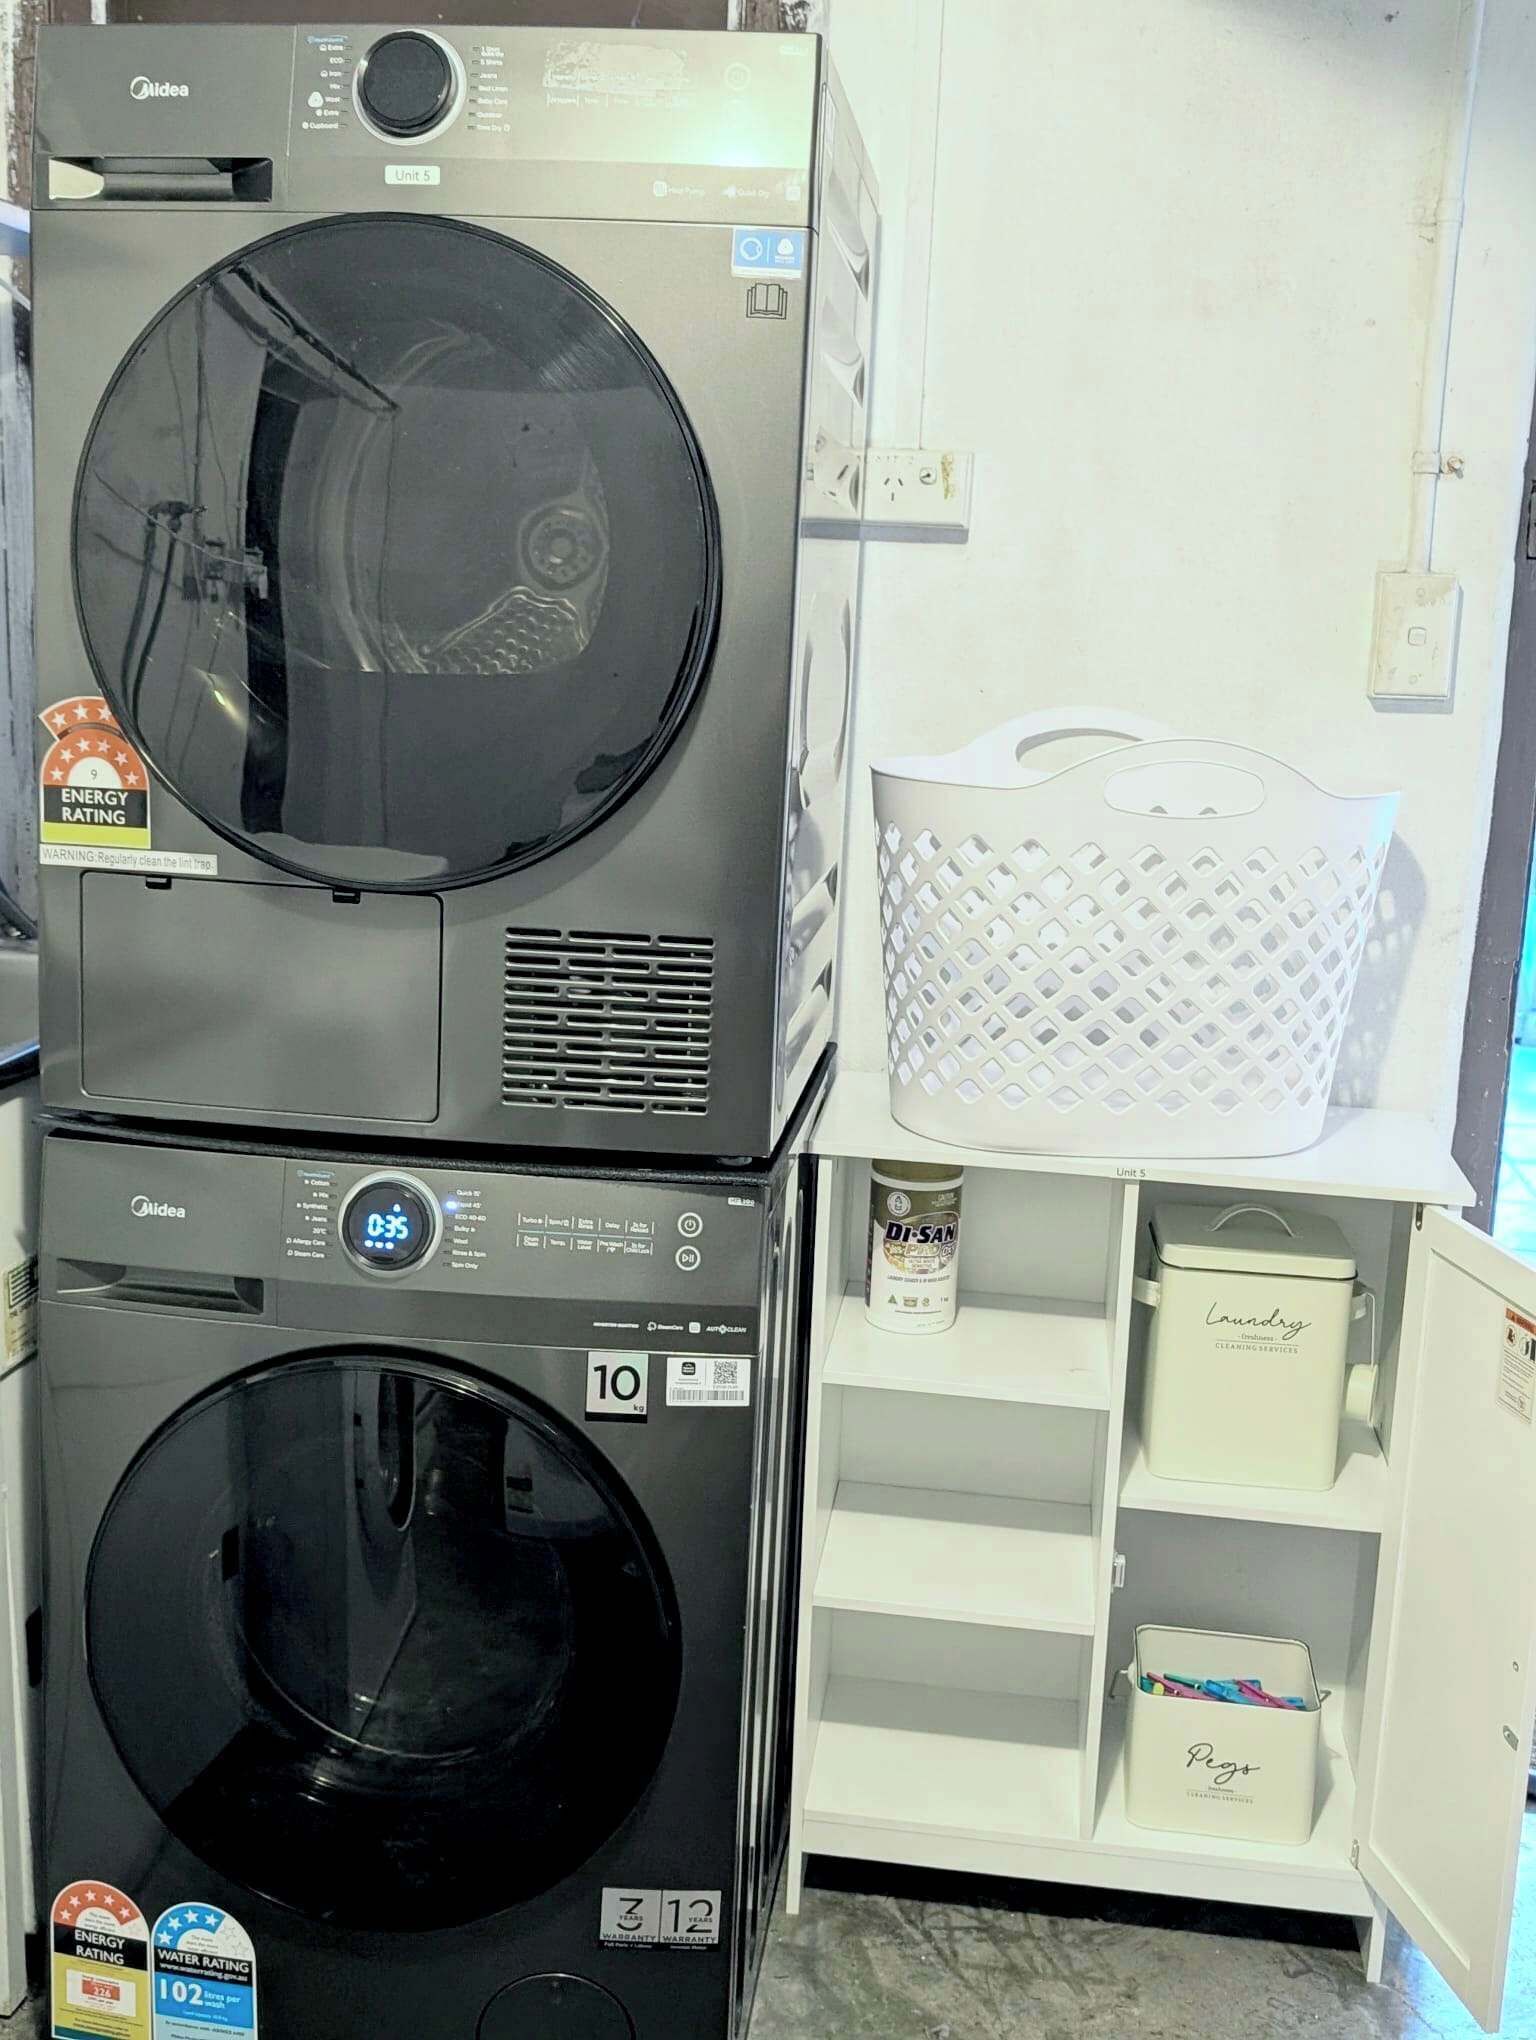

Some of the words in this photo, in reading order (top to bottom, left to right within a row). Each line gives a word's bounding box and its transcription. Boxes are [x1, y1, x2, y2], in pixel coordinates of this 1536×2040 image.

[130, 76, 189, 100] Midea
[395, 169, 420, 181] Unit
[423, 169, 431, 181] 5
[90, 768, 98, 780] 9
[61, 789, 129, 806] ENERGY
[61, 807, 126, 825] RATING
[1116, 1168, 1137, 1177] Unit
[1140, 1168, 1146, 1178] 5
[131, 1195, 186, 1218] Midea
[1205, 1301, 1312, 1341] Laundry
[1215, 1342, 1257, 1352] CLEANING
[1258, 1345, 1299, 1354] SERVICES
[593, 1364, 641, 1401] 10
[633, 1403, 645, 1412] kg
[1186, 1742, 1261, 1785] Pegs
[616, 1897, 644, 1931] 3
[667, 1899, 714, 1933] 12
[75, 1929, 126, 1950] ENERGY
[602, 1933, 656, 1942] WARRANTY
[662, 1935, 717, 1943] WARRANTY
[76, 1945, 124, 1965] RATING
[157, 1949, 200, 1965] WATER
[203, 1957, 250, 1973] RATING
[160, 1978, 204, 2006] 102
[226, 1995, 241, 2003] per
[204, 2001, 226, 2009] wash
